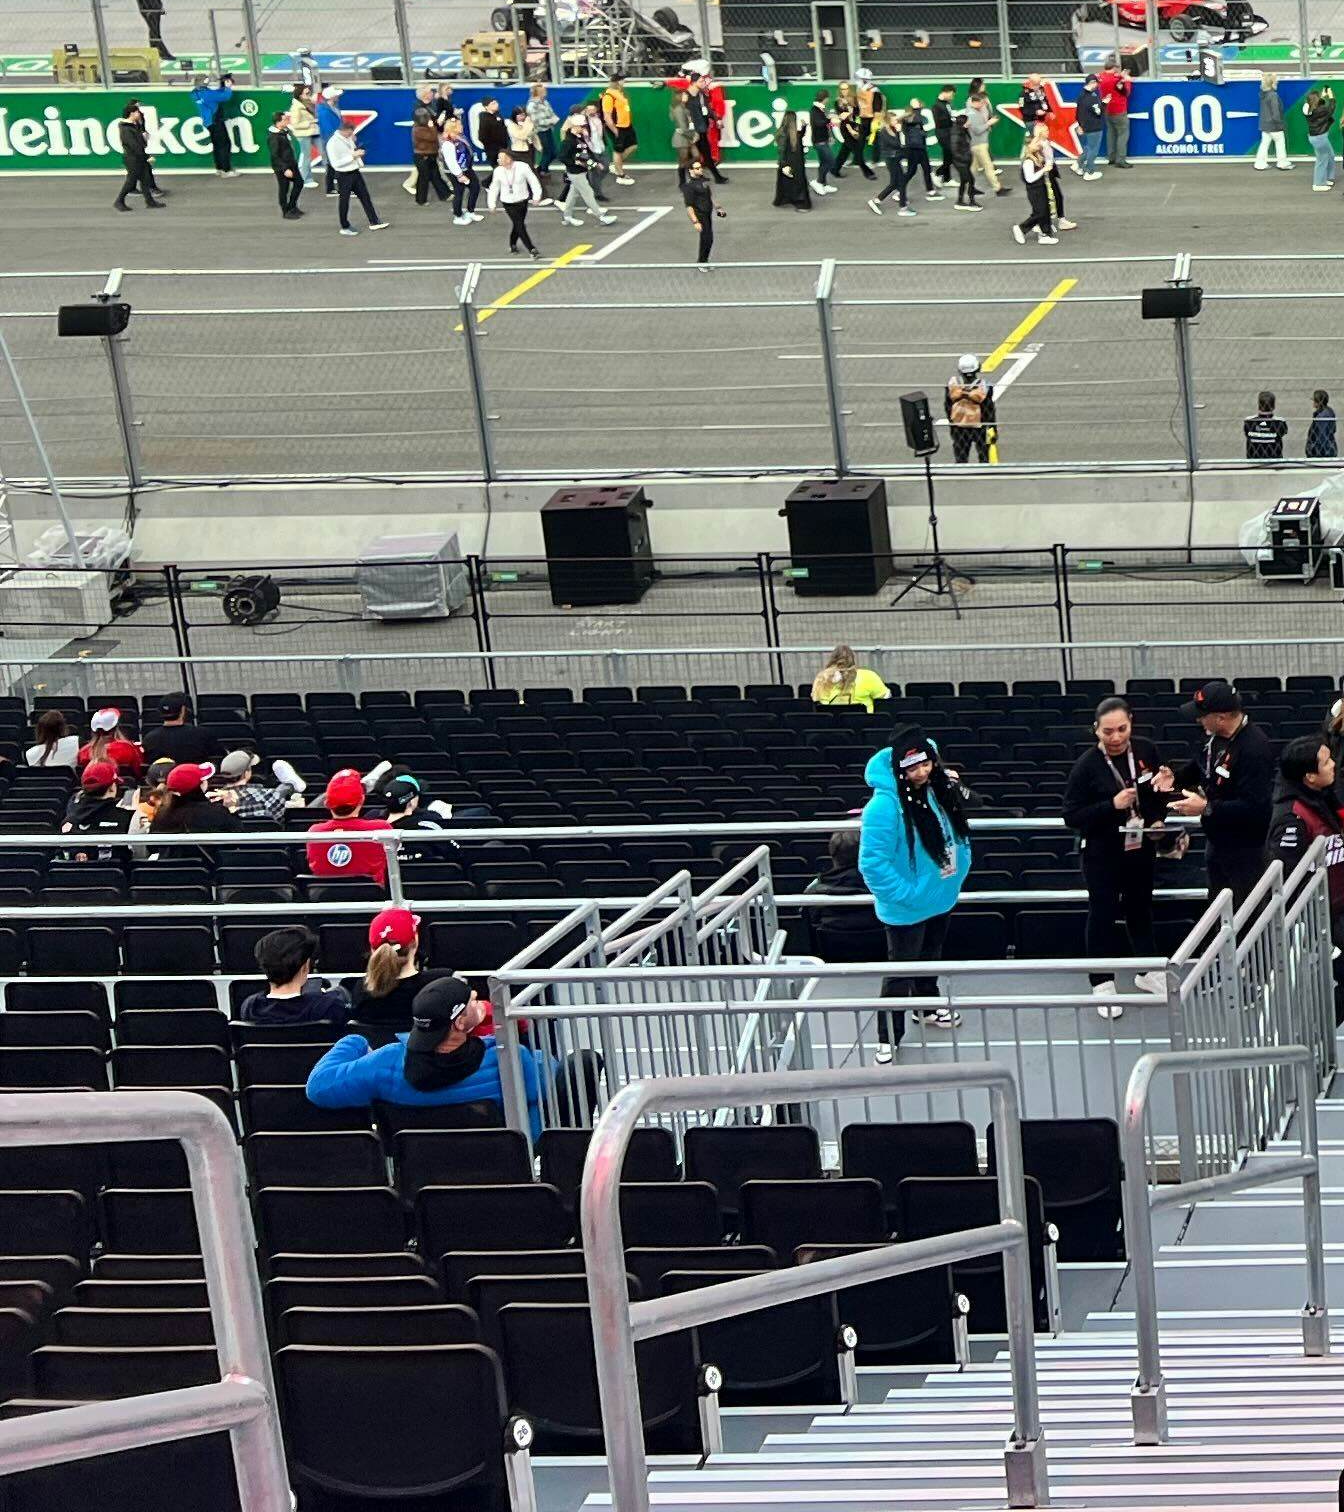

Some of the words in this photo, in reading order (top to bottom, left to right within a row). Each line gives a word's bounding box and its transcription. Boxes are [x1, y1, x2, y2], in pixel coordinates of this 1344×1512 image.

[1203, 56, 1215, 77] 3
[1153, 94, 1223, 143] 0.0
[1156, 143, 1199, 154] ALCOHOL
[1202, 143, 1225, 154] FREE
[331, 844, 349, 865] hp
